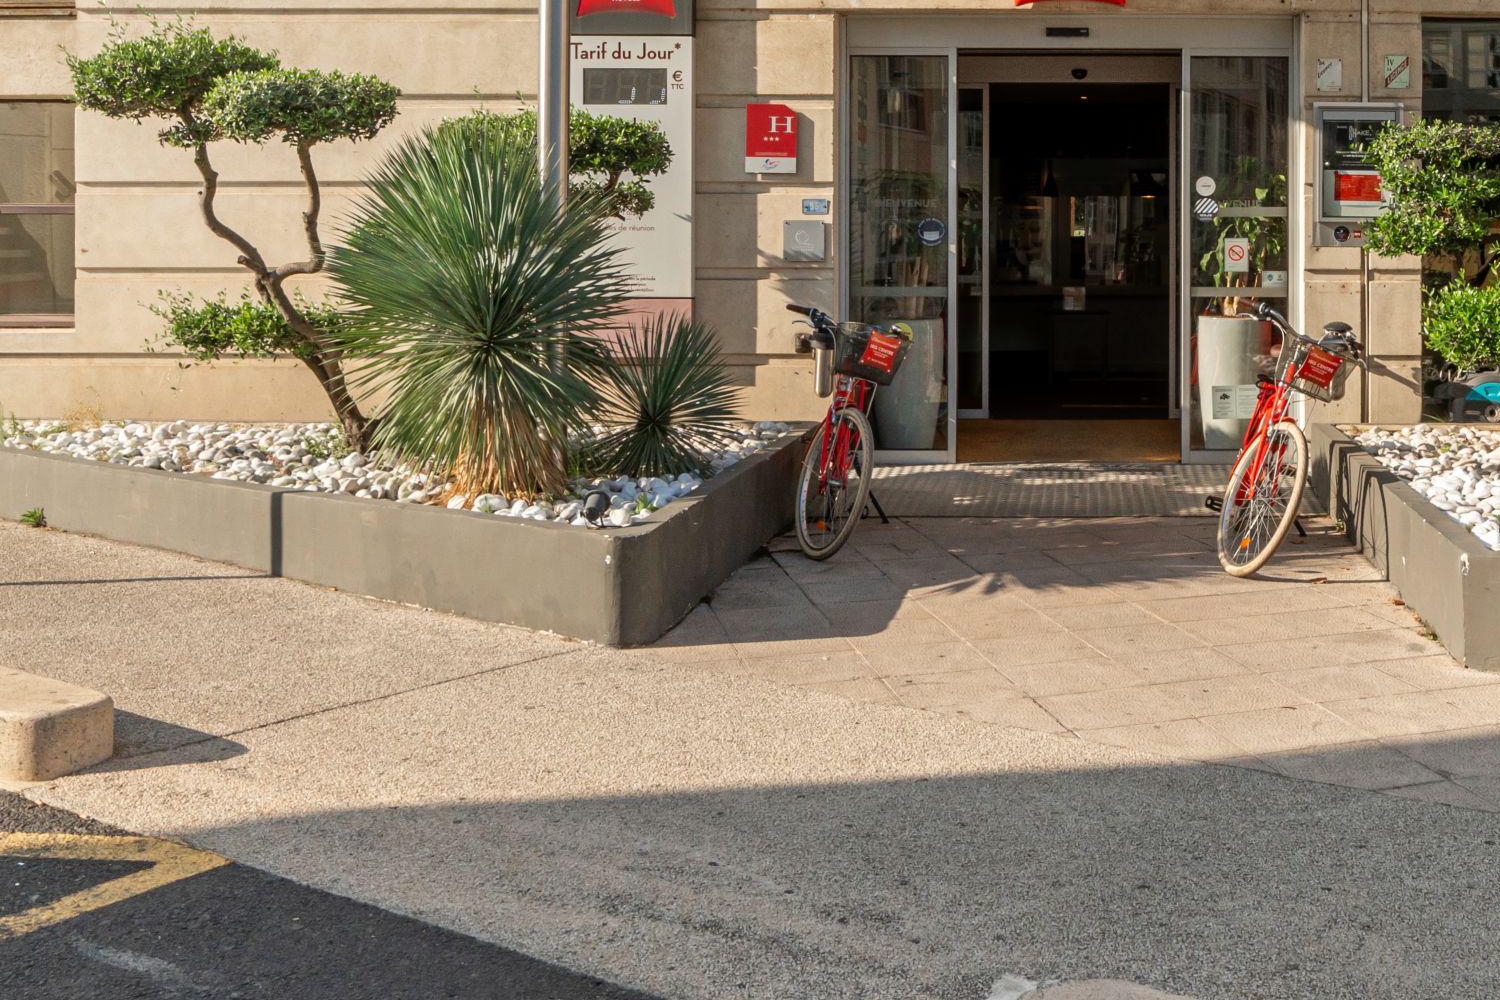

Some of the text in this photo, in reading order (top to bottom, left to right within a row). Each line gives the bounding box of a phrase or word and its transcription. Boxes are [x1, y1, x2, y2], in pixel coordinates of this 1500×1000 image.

[570, 41, 607, 60] Tarif
[611, 41, 631, 60] du
[768, 115, 796, 134] H
